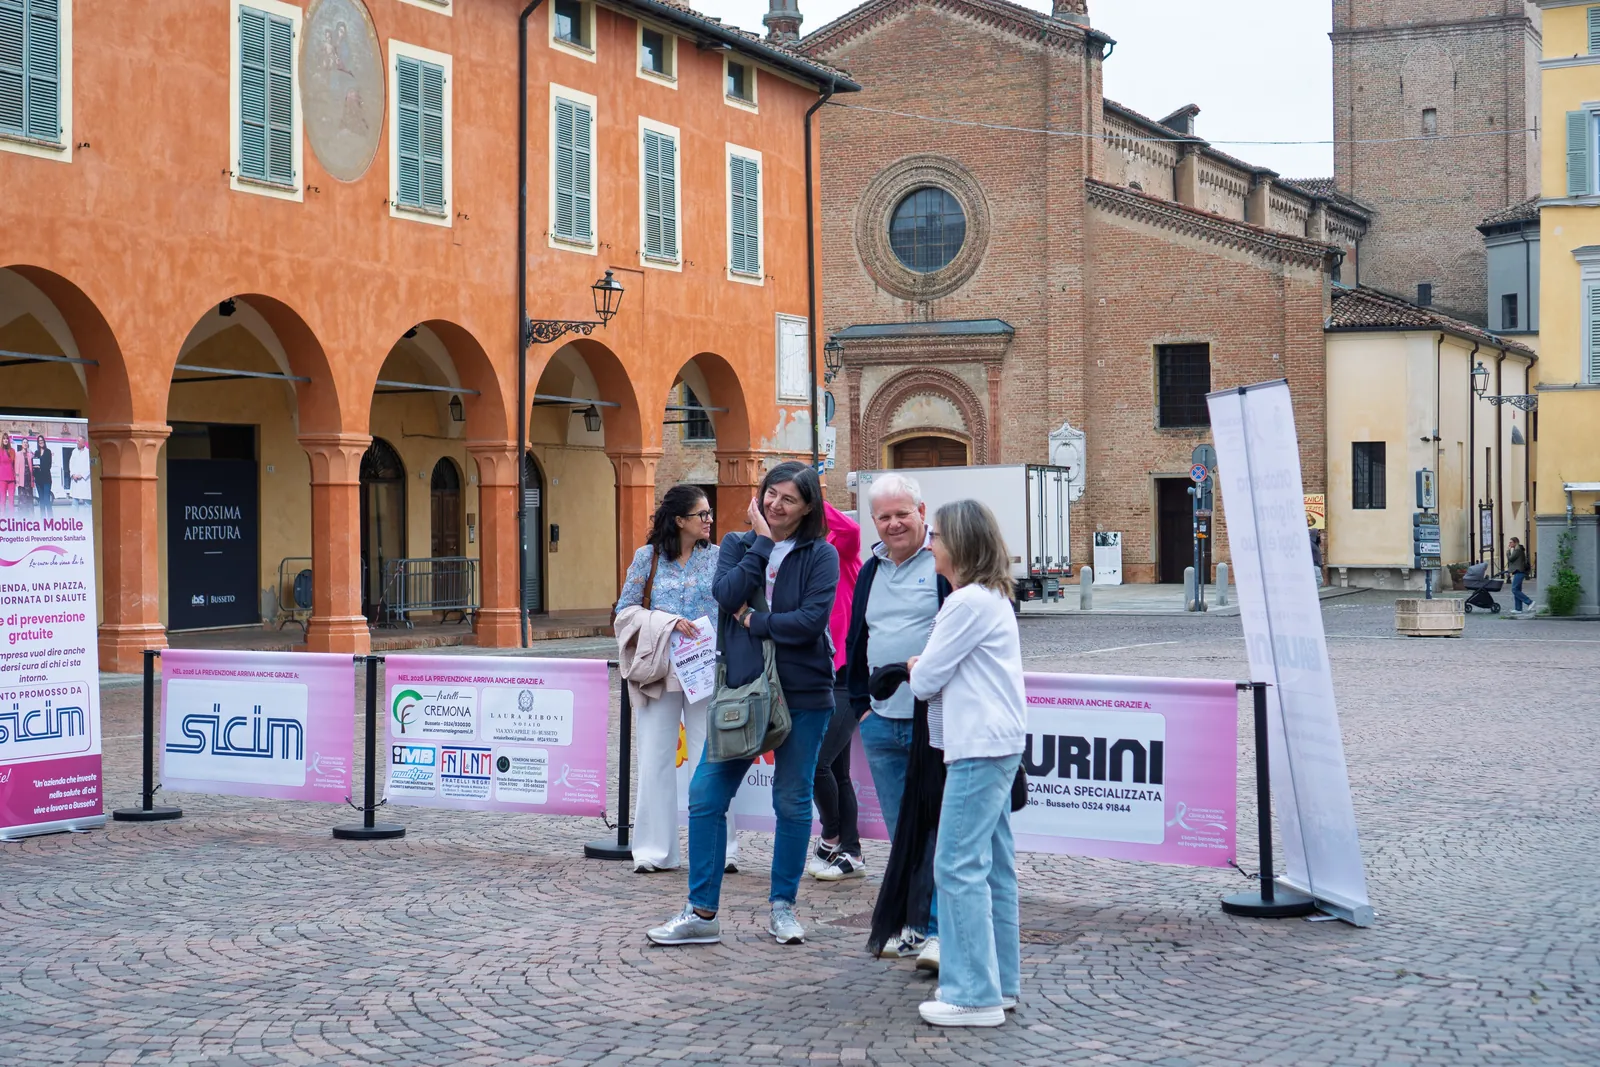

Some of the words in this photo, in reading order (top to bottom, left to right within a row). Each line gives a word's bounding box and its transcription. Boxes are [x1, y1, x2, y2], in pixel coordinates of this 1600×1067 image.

[184, 505, 242, 520] PROSSIMA
[0, 518, 41, 532] Clinica
[43, 517, 84, 531] Mobile
[184, 525, 242, 541] APERTURA
[0, 536, 24, 544] Progetto
[50, 554, 58, 566] che
[32, 582, 51, 591] UNA
[53, 581, 87, 591] PIAZZA,
[44, 594, 53, 603] DI
[55, 593, 87, 602] SALUTE
[210, 595, 235, 604] BUSSETO
[7, 613, 18, 626] di
[20, 611, 86, 628] prevenzione
[9, 628, 54, 645] gratuite
[30, 649, 46, 657] vuol
[47, 648, 62, 656] dire
[63, 647, 86, 655] anche
[22, 663, 39, 671] cura
[40, 660, 48, 669] di
[49, 659, 61, 668] chi
[62, 659, 69, 667] ci
[70, 659, 81, 667] sta
[19, 674, 49, 683] intorno.
[19, 687, 68, 699] PROMOSSO
[70, 686, 82, 695] DA
[1057, 697, 1084, 706] ARRIVA
[1085, 699, 1112, 708] ANCHE
[1114, 700, 1142, 709] GRAZIE
[1144, 702, 1151, 710] A:
[424, 705, 472, 717] CREMONA
[166, 703, 303, 760] sicim
[1022, 733, 1164, 785] URINI
[77, 773, 97, 783] investe
[48, 789, 63, 799] nella
[63, 788, 81, 797] salute
[82, 787, 88, 795] di
[88, 785, 97, 793] chi
[1073, 786, 1162, 802] SPECIALIZZATA
[33, 806, 46, 815] vive
[50, 803, 69, 812] lavora
[1046, 799, 1080, 809] Busseto
[1082, 801, 1104, 811] 0524
[1105, 803, 1131, 812] 91844
